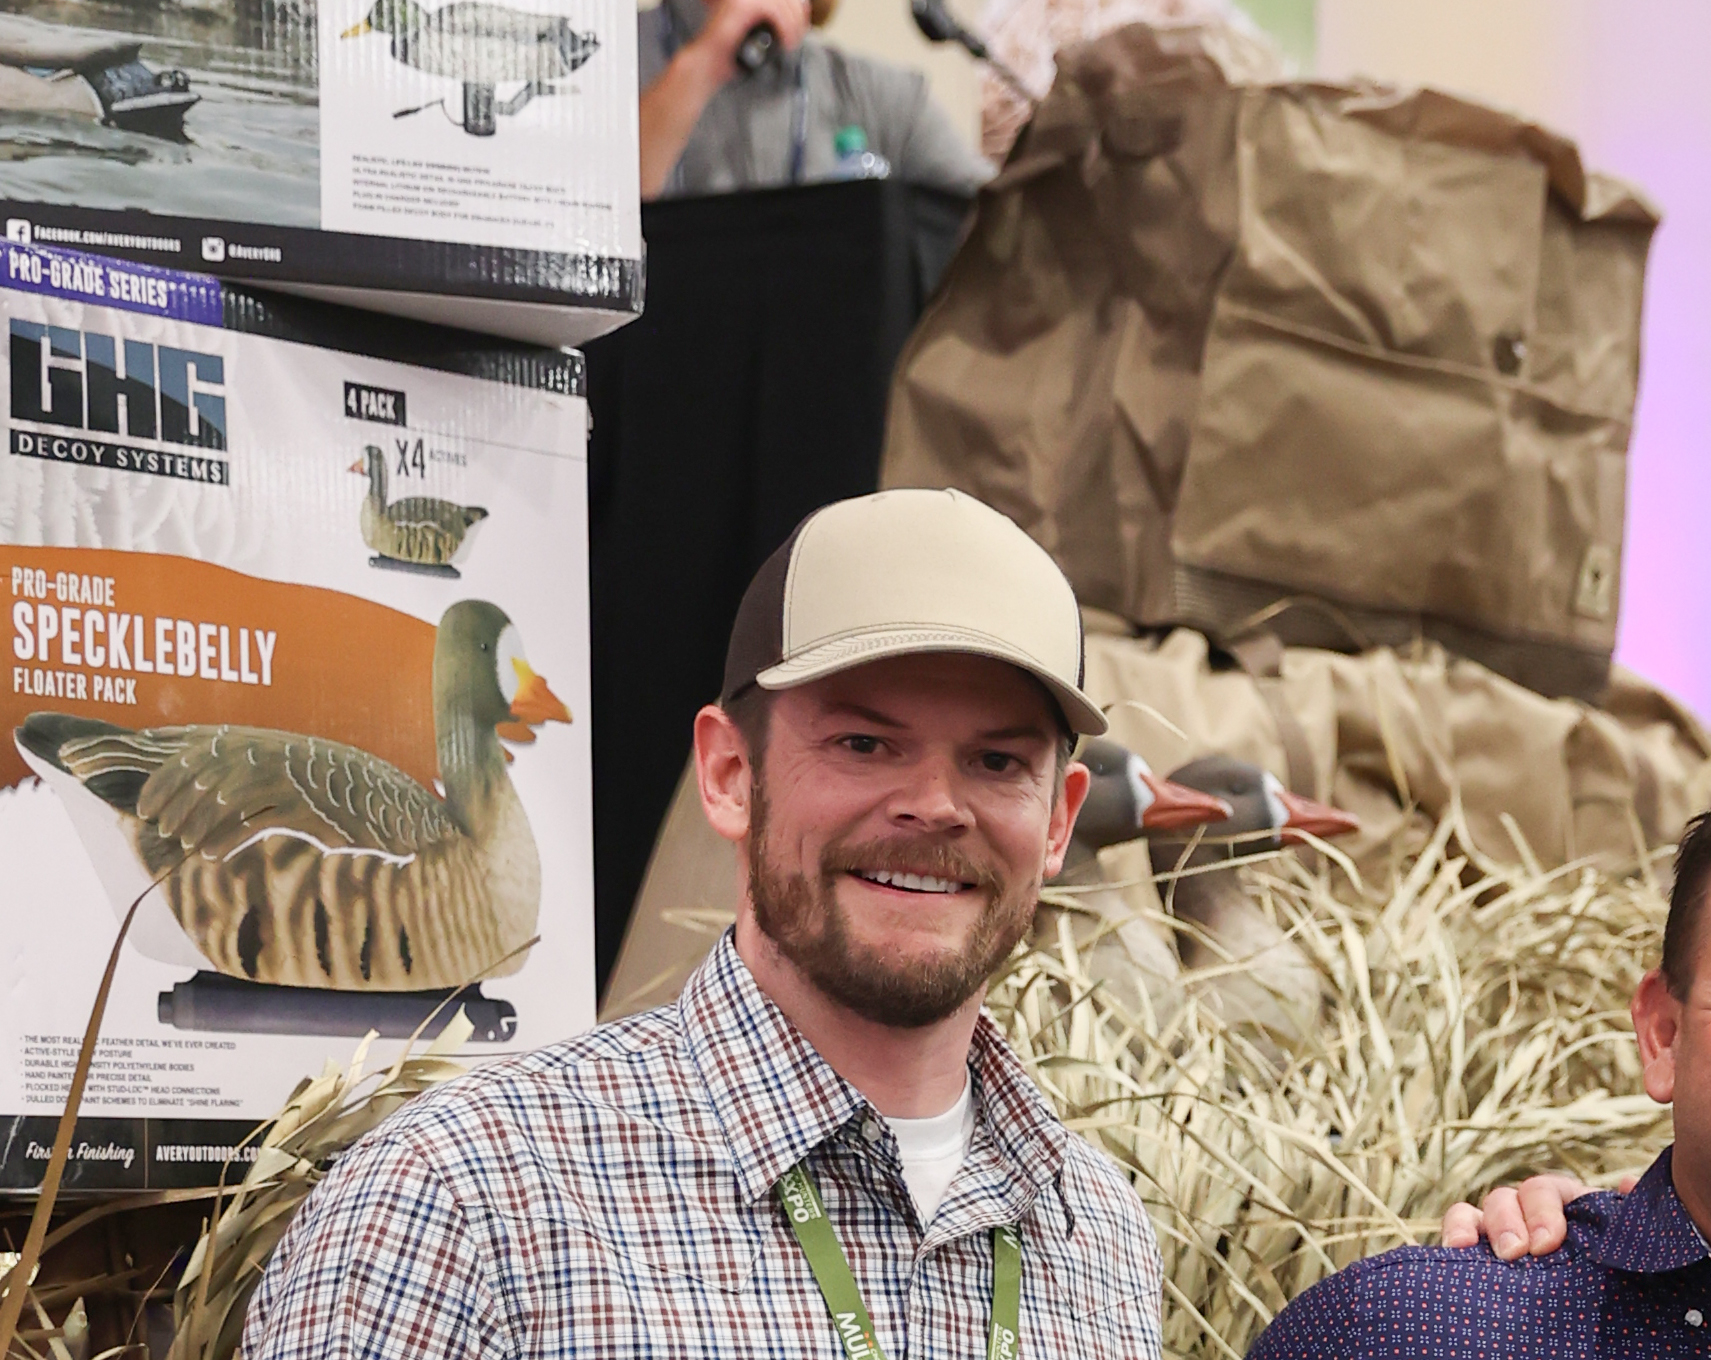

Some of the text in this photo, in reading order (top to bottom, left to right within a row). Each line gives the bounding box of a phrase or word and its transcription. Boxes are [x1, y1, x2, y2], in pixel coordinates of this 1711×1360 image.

[9, 250, 168, 308] PRO-GRADE SERIES
[10, 318, 228, 451] GHG
[347, 387, 396, 420] 4 PACK
[18, 434, 222, 482] DECOY SYSTEMS
[11, 565, 115, 607] PRO-GRADE
[13, 600, 277, 686] SPECKLEBELLY
[13, 667, 137, 705] FLOATER PACK
[25, 1035, 39, 1044] THE
[40, 1036, 60, 1044] MOST
[101, 1038, 133, 1046] FEATHER
[136, 1039, 159, 1048] DETAIL
[205, 1041, 236, 1050] CREATED
[25, 1048, 75, 1057] ACTIVE-STYLE
[99, 1050, 133, 1058] POSTURE
[25, 1059, 59, 1067] DURABLE
[25, 1071, 45, 1079] HAND
[25, 1141, 54, 1160] Firs
[76, 1141, 135, 1169] Finishing
[156, 1145, 261, 1162] AVERYOUTDOORS.CO
